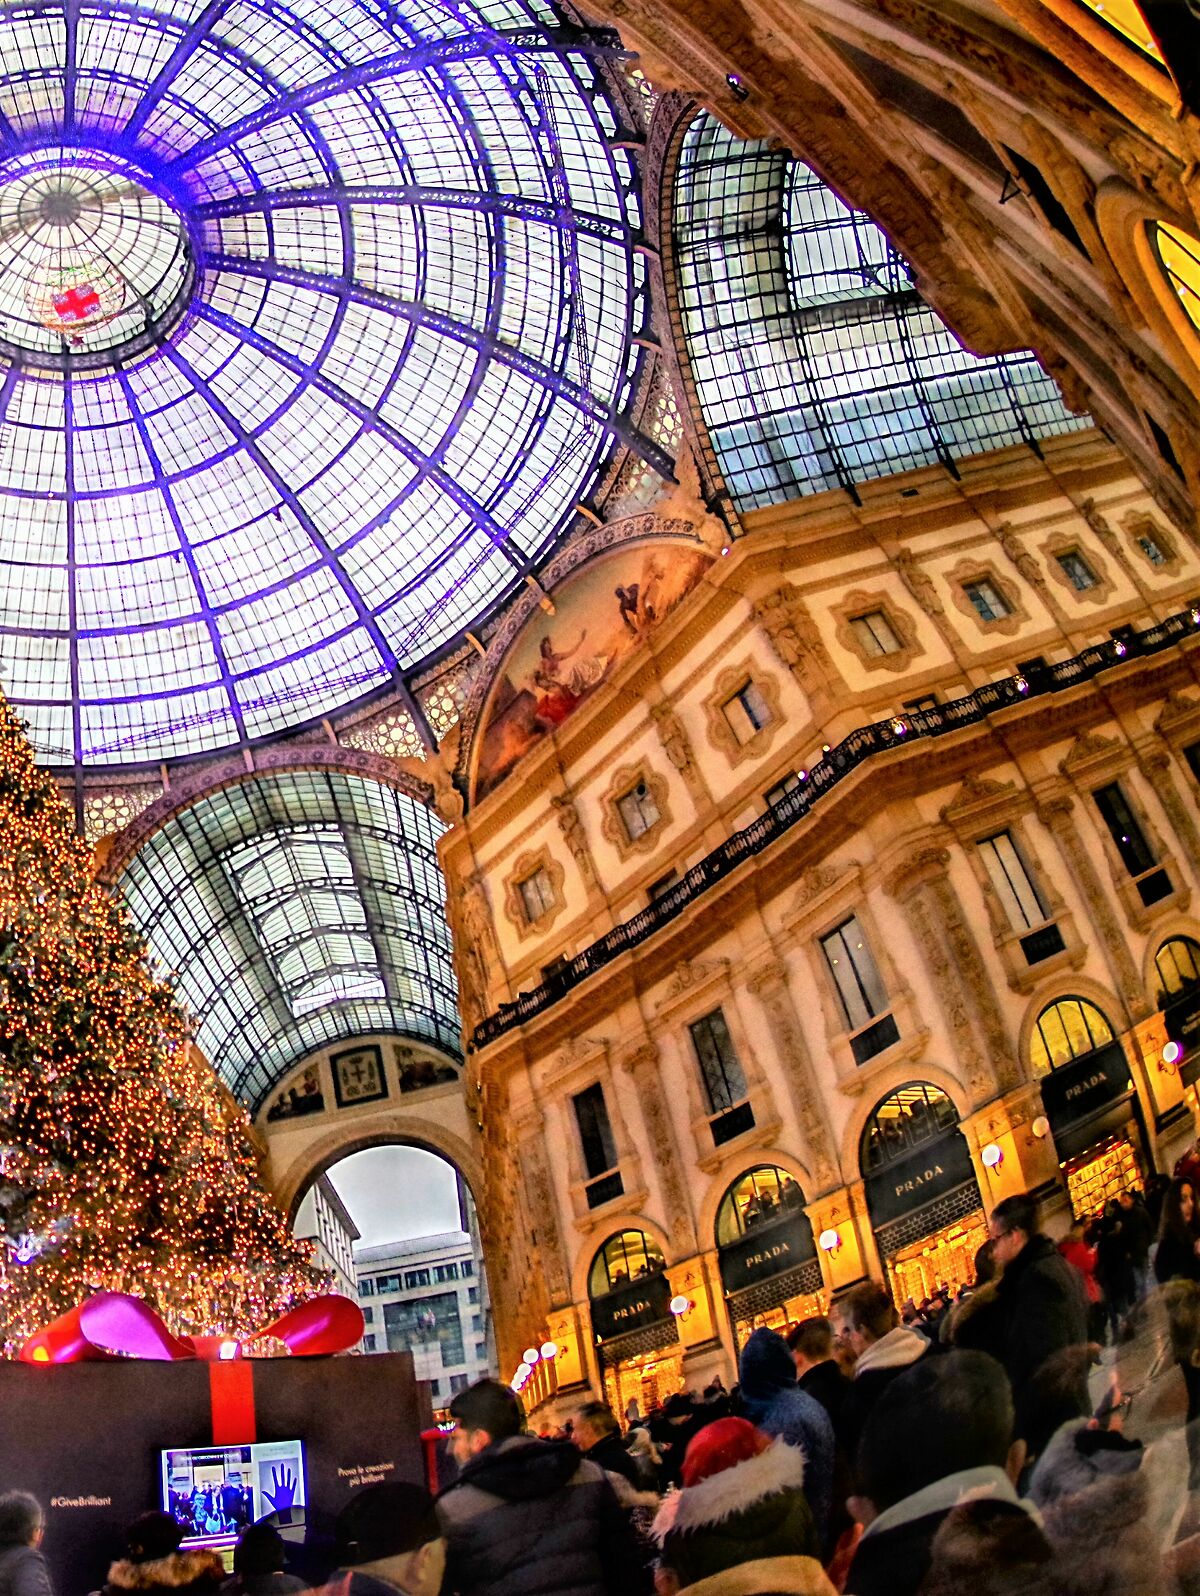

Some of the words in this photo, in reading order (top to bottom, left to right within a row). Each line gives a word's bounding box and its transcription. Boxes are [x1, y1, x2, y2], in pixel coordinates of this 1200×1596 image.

[1065, 1072, 1108, 1100] PRADA
[895, 1165, 944, 1196] PRADA
[745, 1243, 790, 1268] PRADA
[613, 1300, 650, 1320] PRADA
